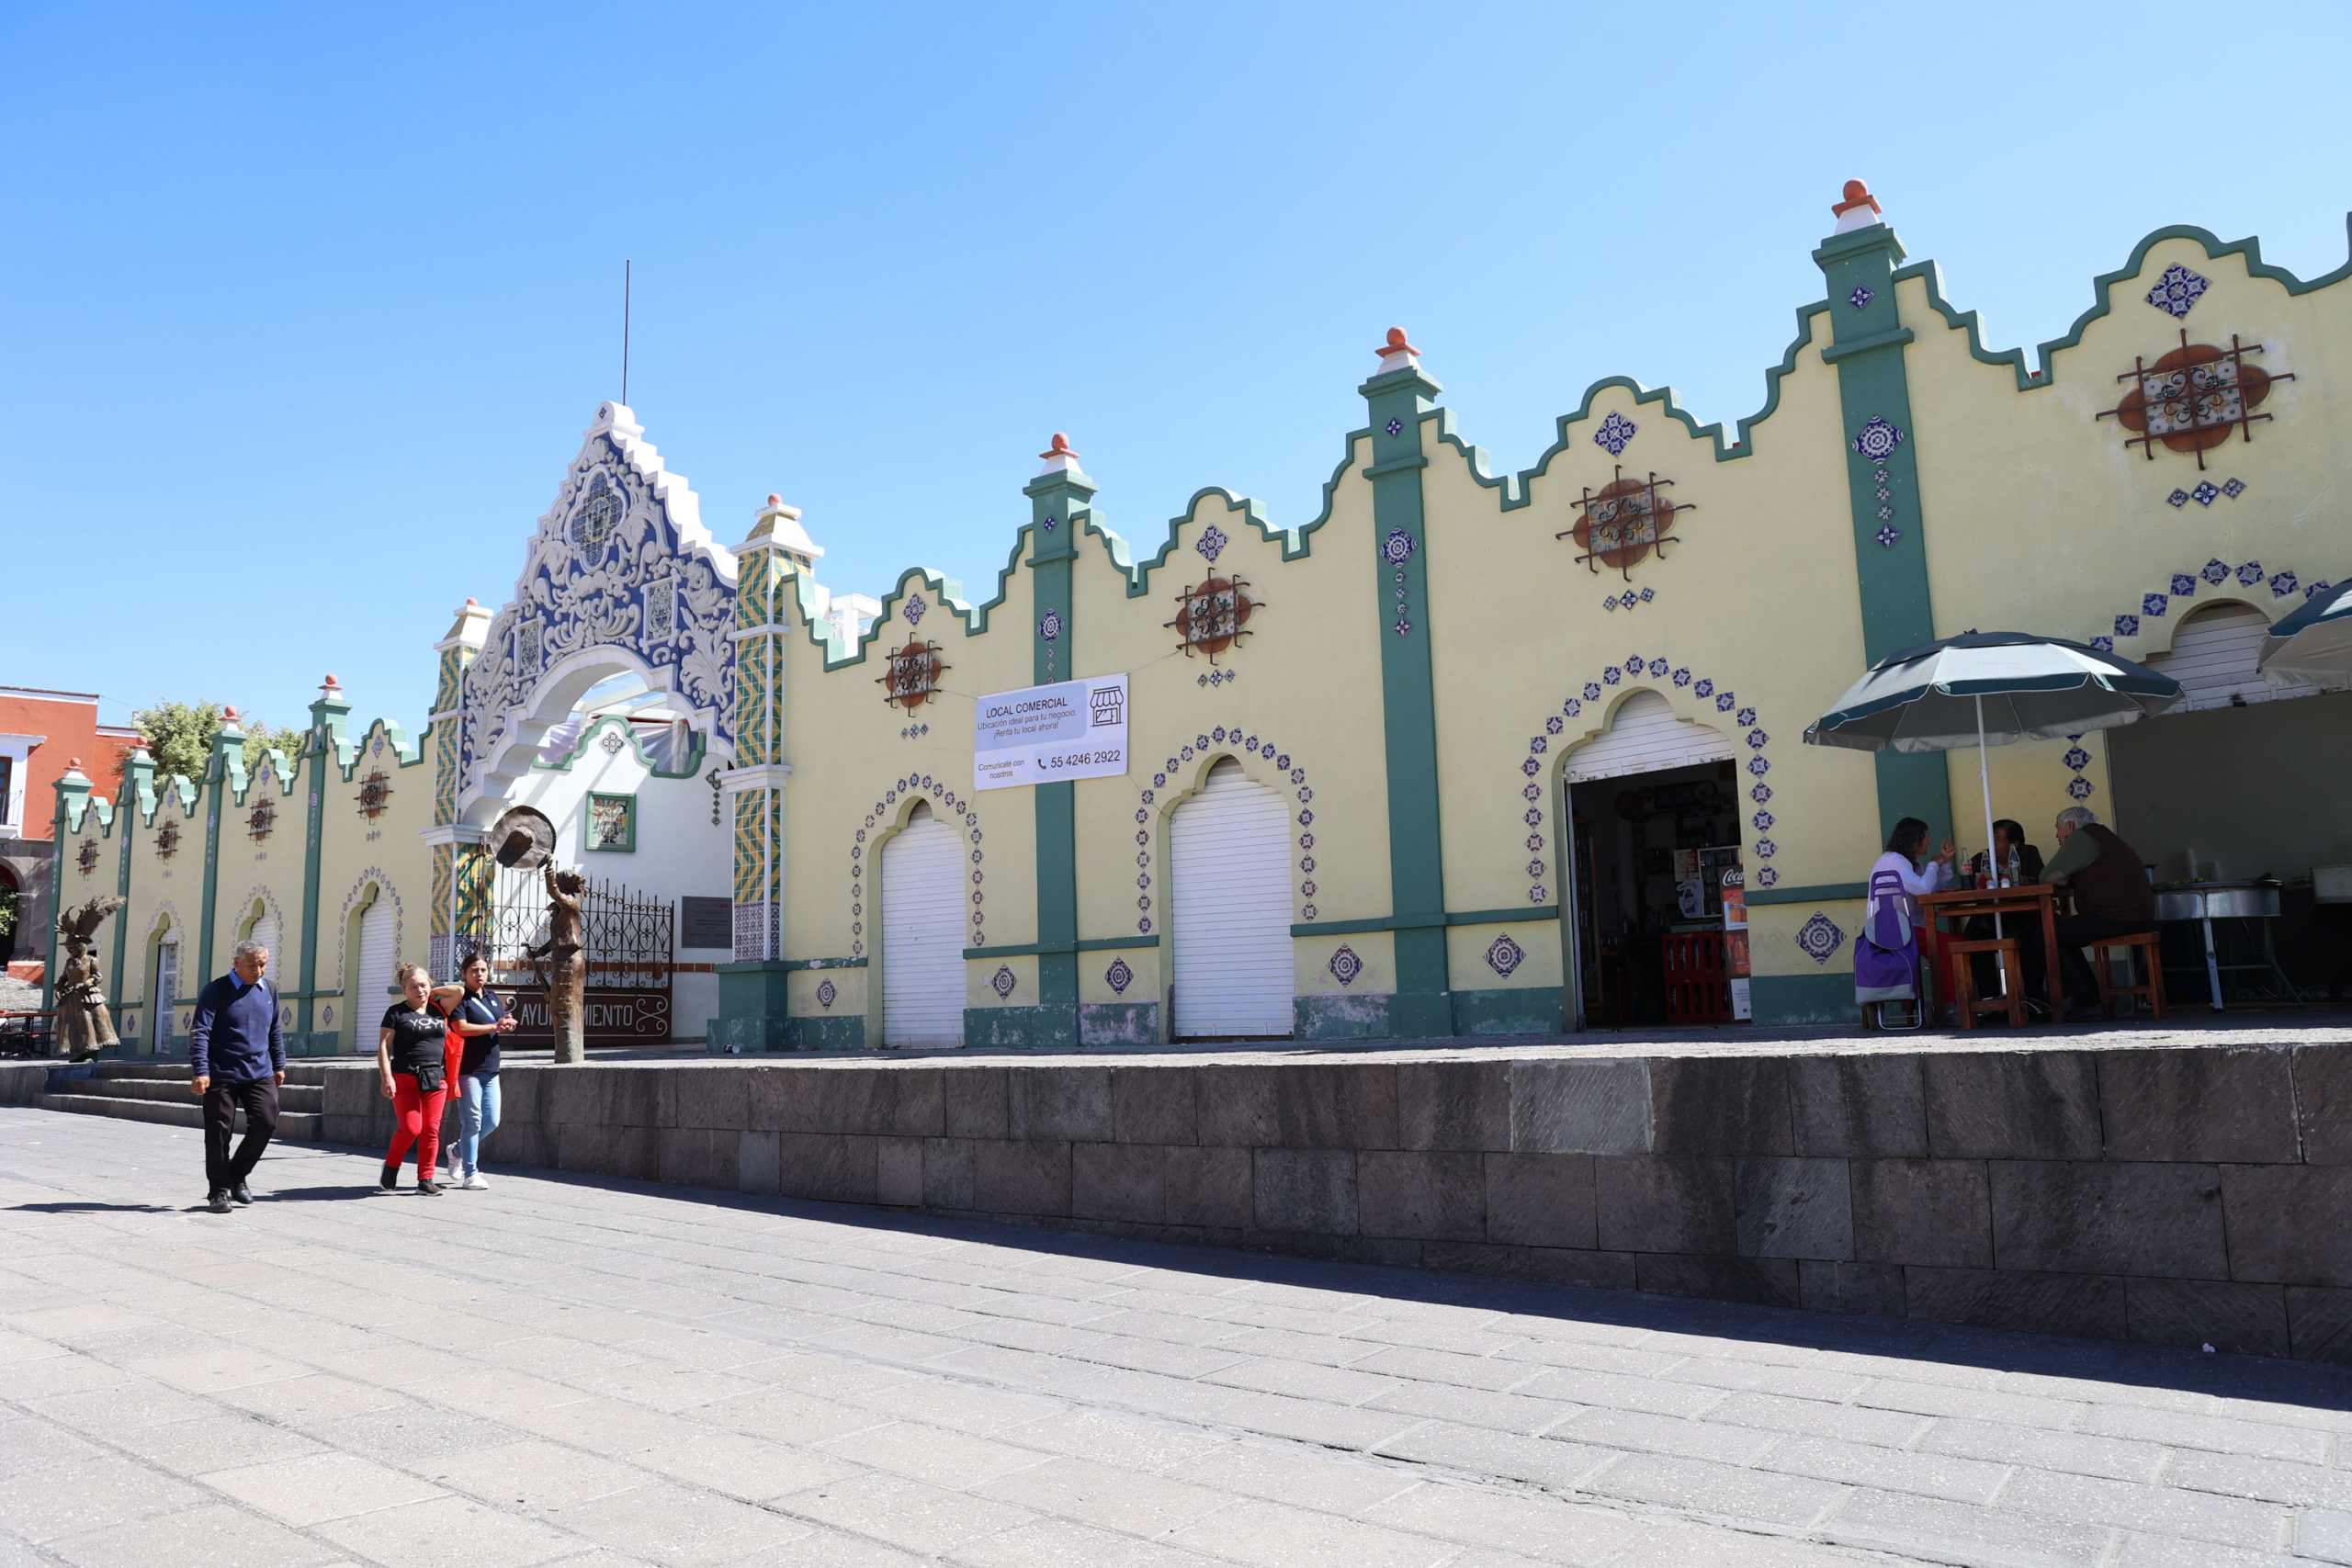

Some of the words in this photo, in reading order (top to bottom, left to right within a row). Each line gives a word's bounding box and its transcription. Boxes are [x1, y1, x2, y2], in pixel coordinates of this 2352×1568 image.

[986, 706, 1014, 718] LOCAL
[1016, 696, 1068, 714] COMERCIAL
[1008, 716, 1024, 726] ideal
[1024, 714, 1039, 724] para
[1040, 711, 1047, 720] tu
[1013, 727, 1021, 735] tu
[1022, 725, 1037, 734] local
[1038, 721, 1059, 731] ahora!
[1012, 760, 1025, 768] con
[1050, 757, 1063, 769] 55
[1066, 752, 1091, 766] 4246
[1093, 750, 1121, 763] 2922
[989, 771, 1013, 780] nosotros
[520, 1003, 633, 1027] AYUIENTO
